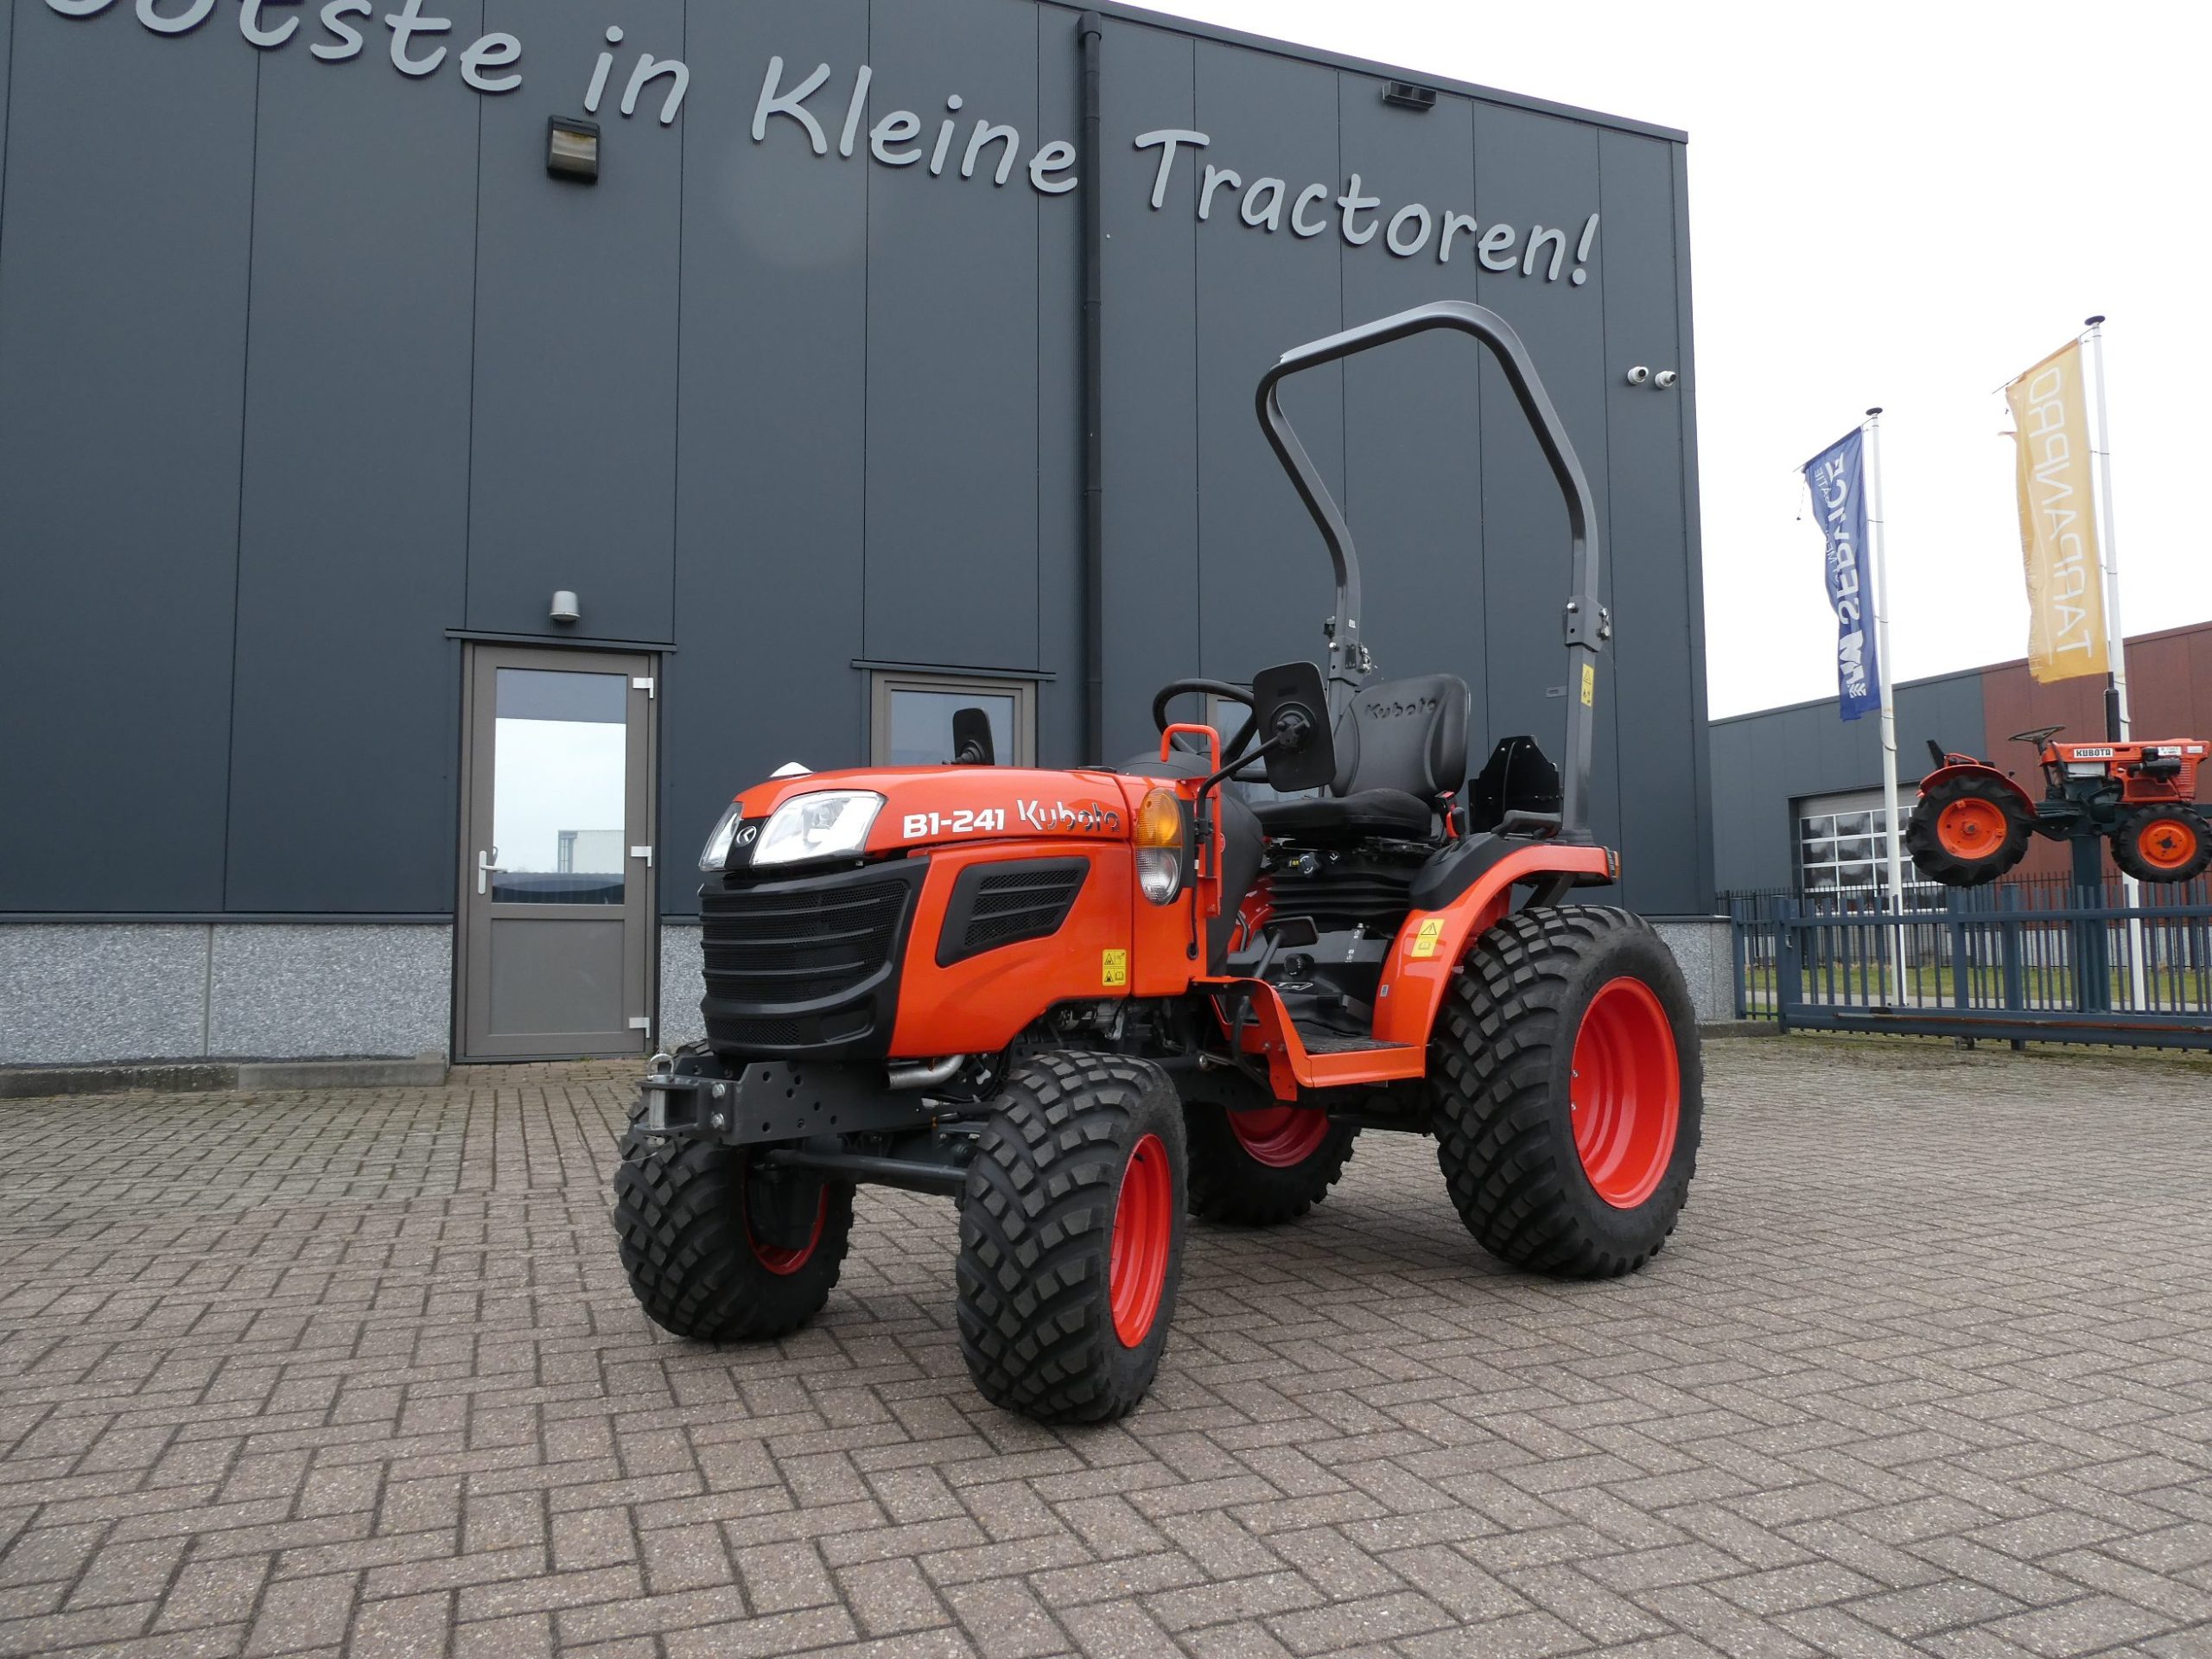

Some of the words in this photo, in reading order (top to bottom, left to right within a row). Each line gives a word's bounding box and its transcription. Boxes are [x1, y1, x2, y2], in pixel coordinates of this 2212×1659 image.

[584, 25, 690, 124] in
[752, 55, 1078, 194] Kleine
[1135, 129, 1600, 286] Tractoren!
[1364, 696, 1438, 720] Kubota
[2075, 747, 2112, 757] KUBOTA
[902, 808, 1005, 839] B1-241
[1016, 799, 1121, 833] Kubota
